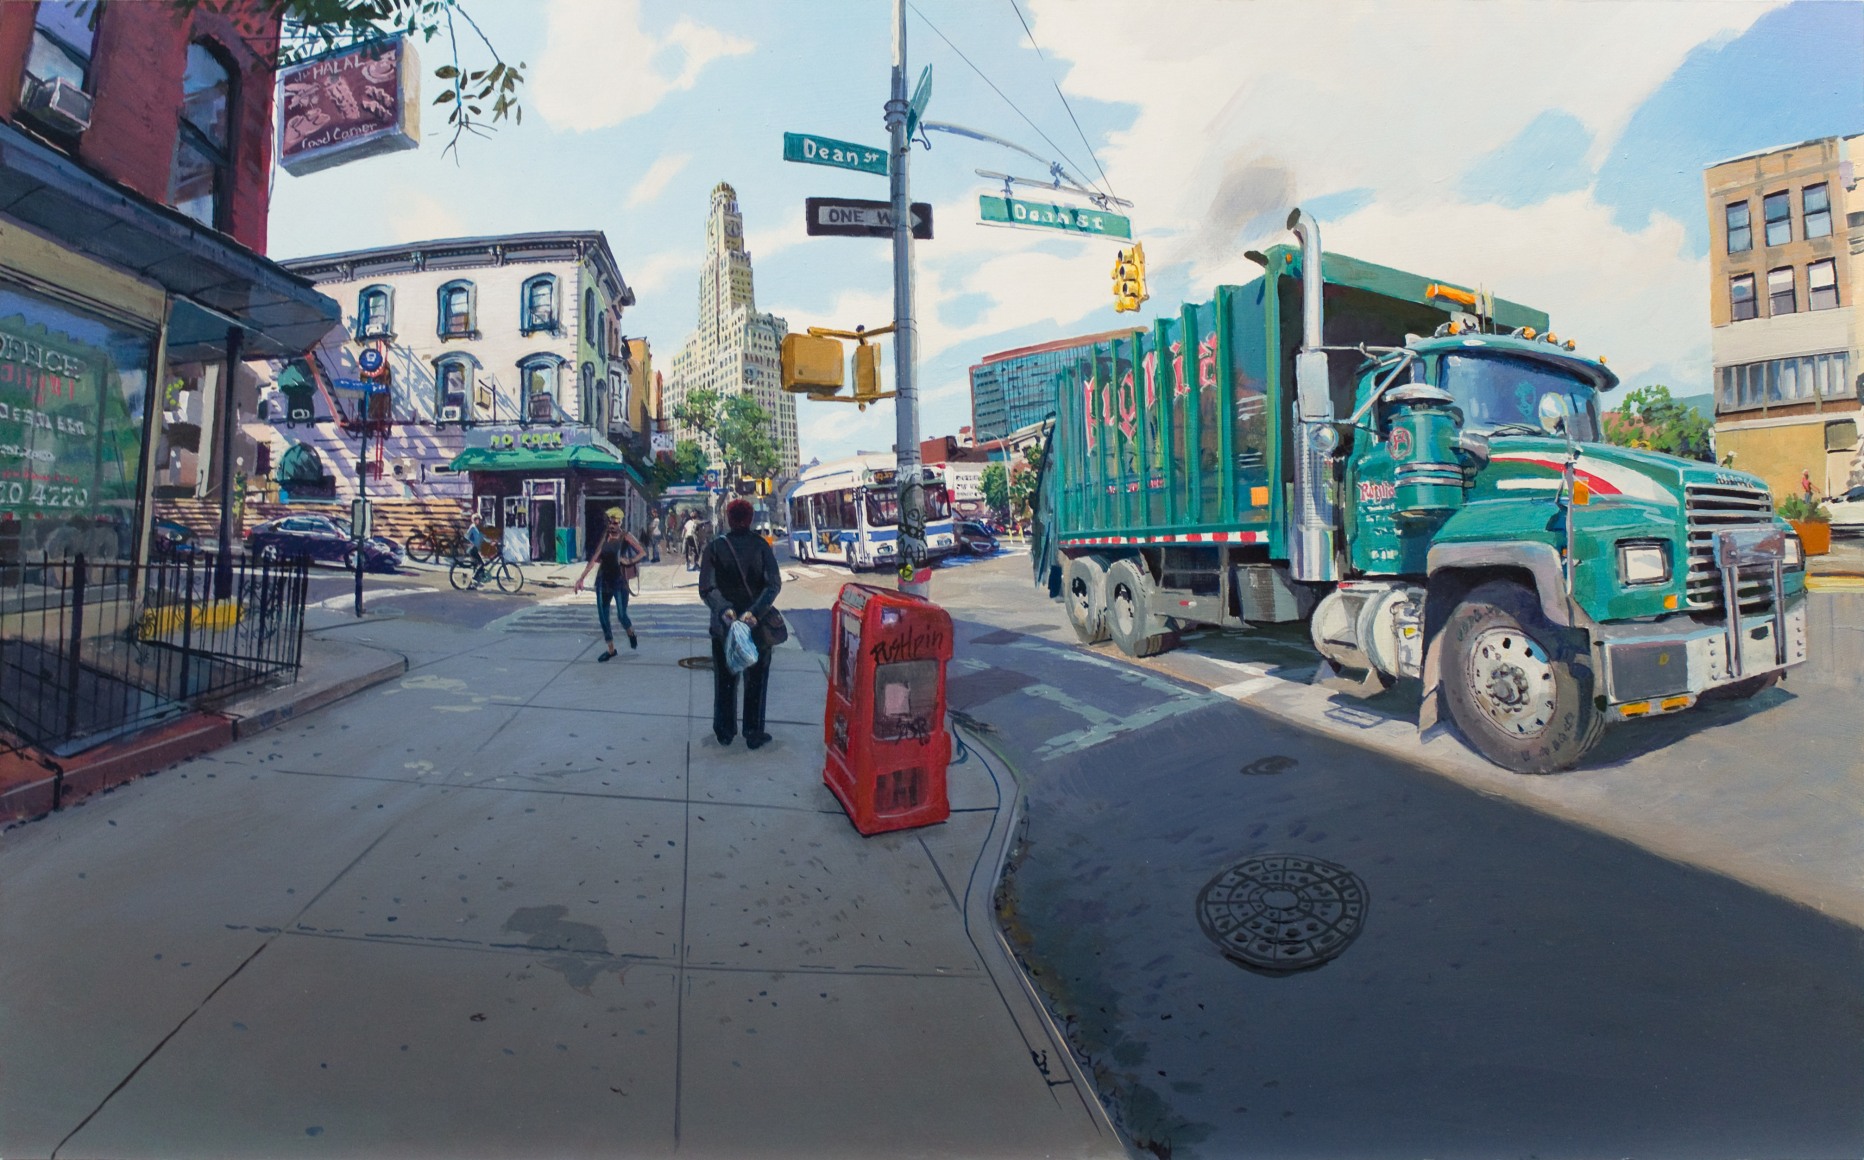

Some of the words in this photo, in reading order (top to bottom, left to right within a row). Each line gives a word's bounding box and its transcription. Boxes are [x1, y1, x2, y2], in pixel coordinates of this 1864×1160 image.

[313, 55, 365, 79] HALAL
[803, 138, 858, 165] Dean
[829, 208, 864, 223] ONE
[1014, 203, 1070, 225] Dean
